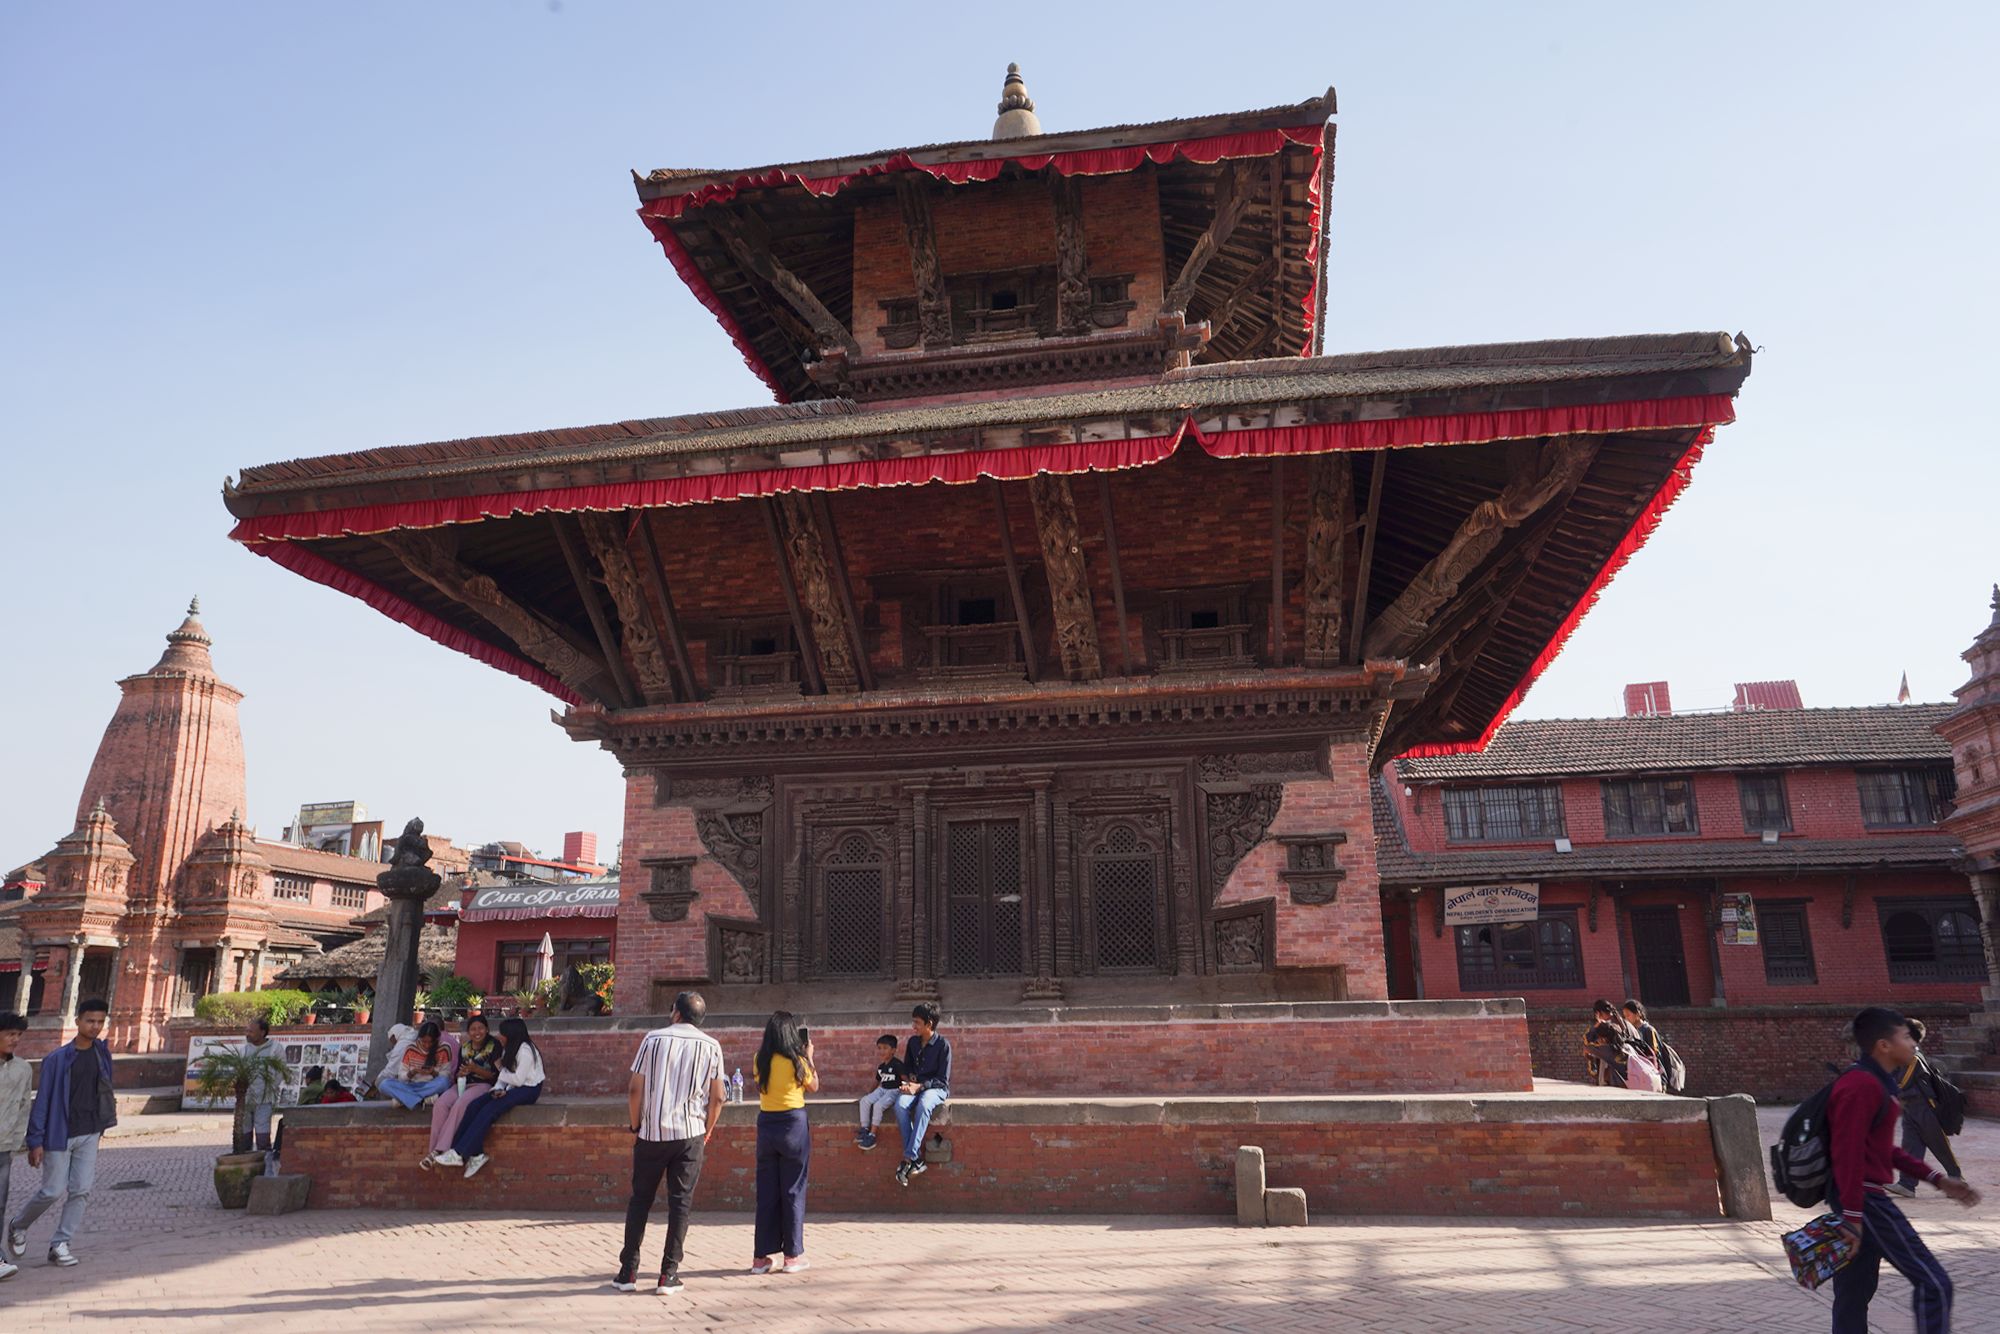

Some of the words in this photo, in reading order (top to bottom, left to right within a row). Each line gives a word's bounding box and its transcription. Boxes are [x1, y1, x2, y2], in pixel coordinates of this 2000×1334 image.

[478, 890, 524, 907] CAFE
[523, 889, 566, 905] DE
[565, 887, 620, 903] TRAD
[1447, 890, 1475, 909] नेपाल
[1477, 887, 1498, 896] बाल
